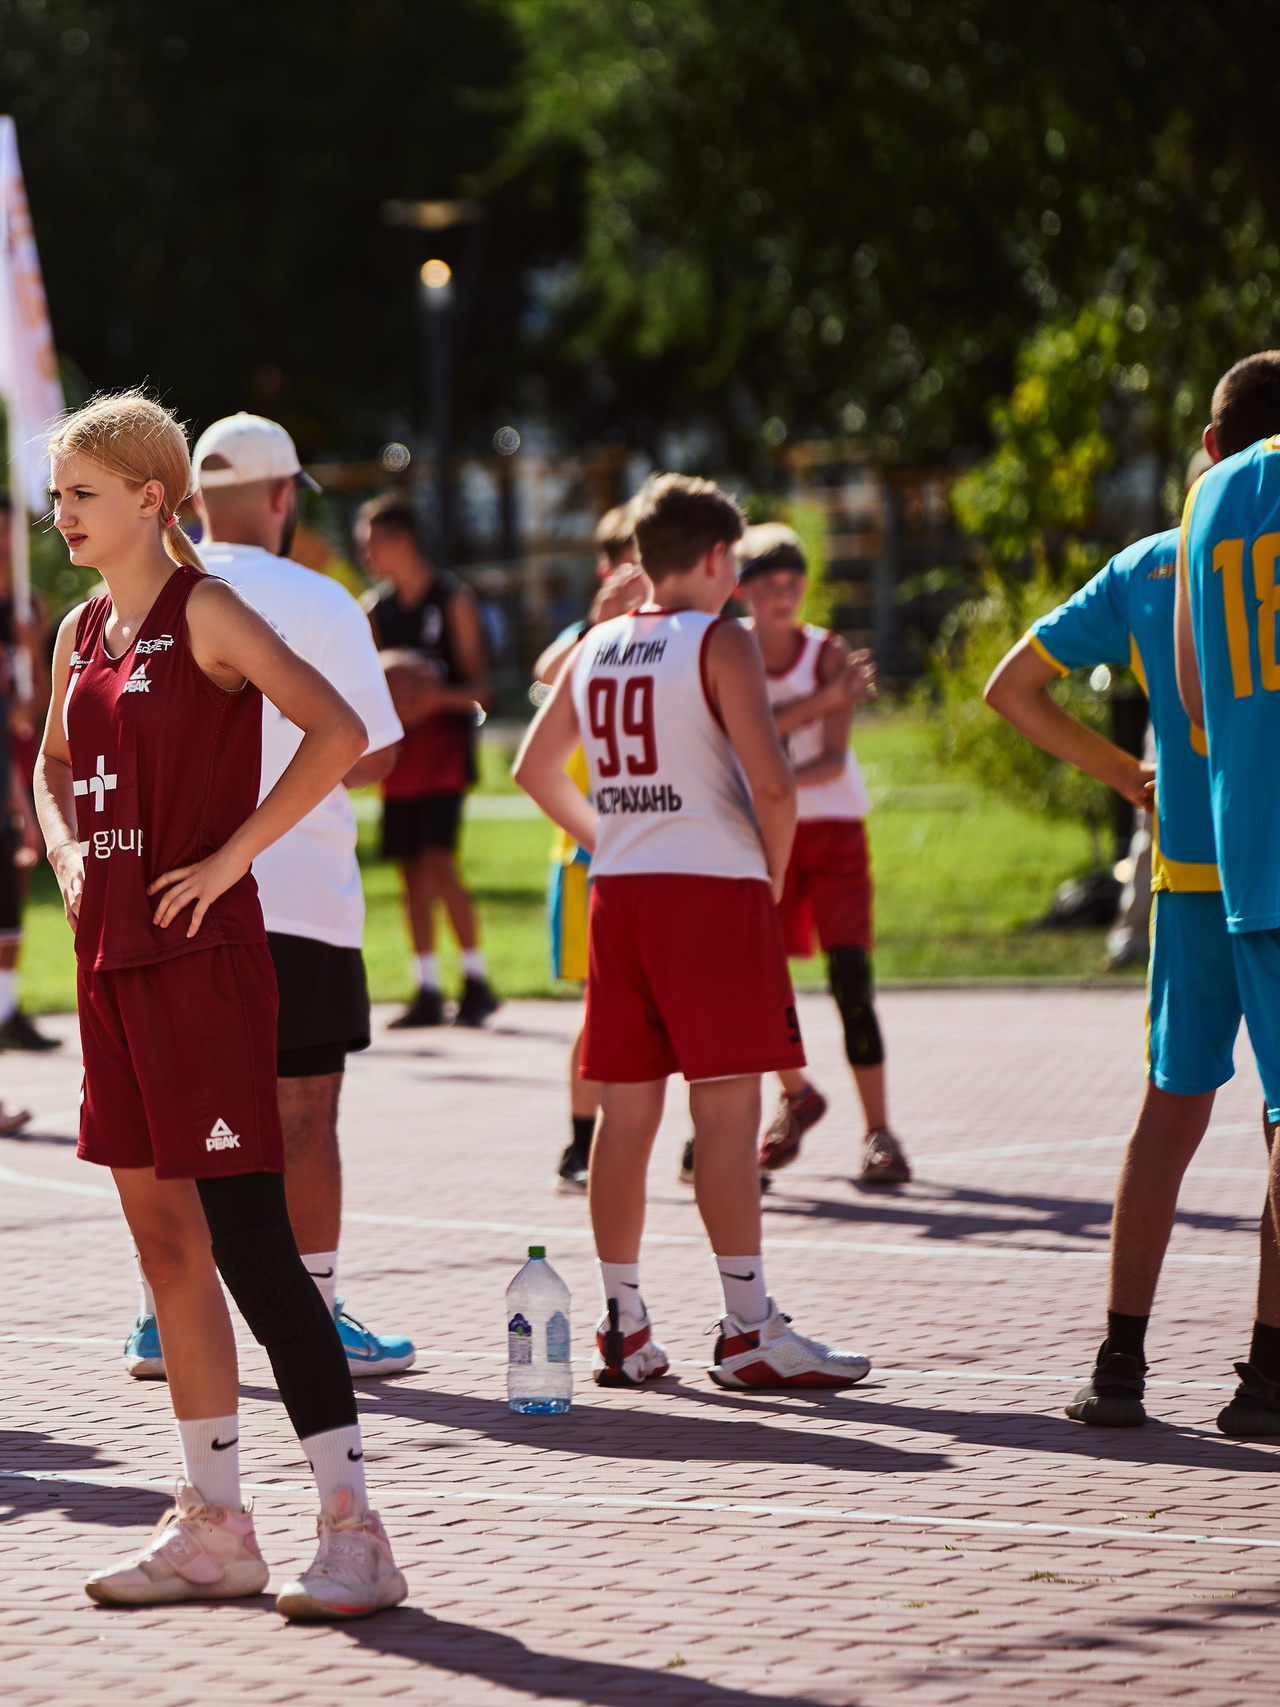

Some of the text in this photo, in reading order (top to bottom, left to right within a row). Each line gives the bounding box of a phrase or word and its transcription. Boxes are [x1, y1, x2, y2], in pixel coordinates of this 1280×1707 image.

[123, 679, 152, 693] PEAK
[588, 675, 659, 778] 99
[205, 1134, 241, 1152] PEAK
